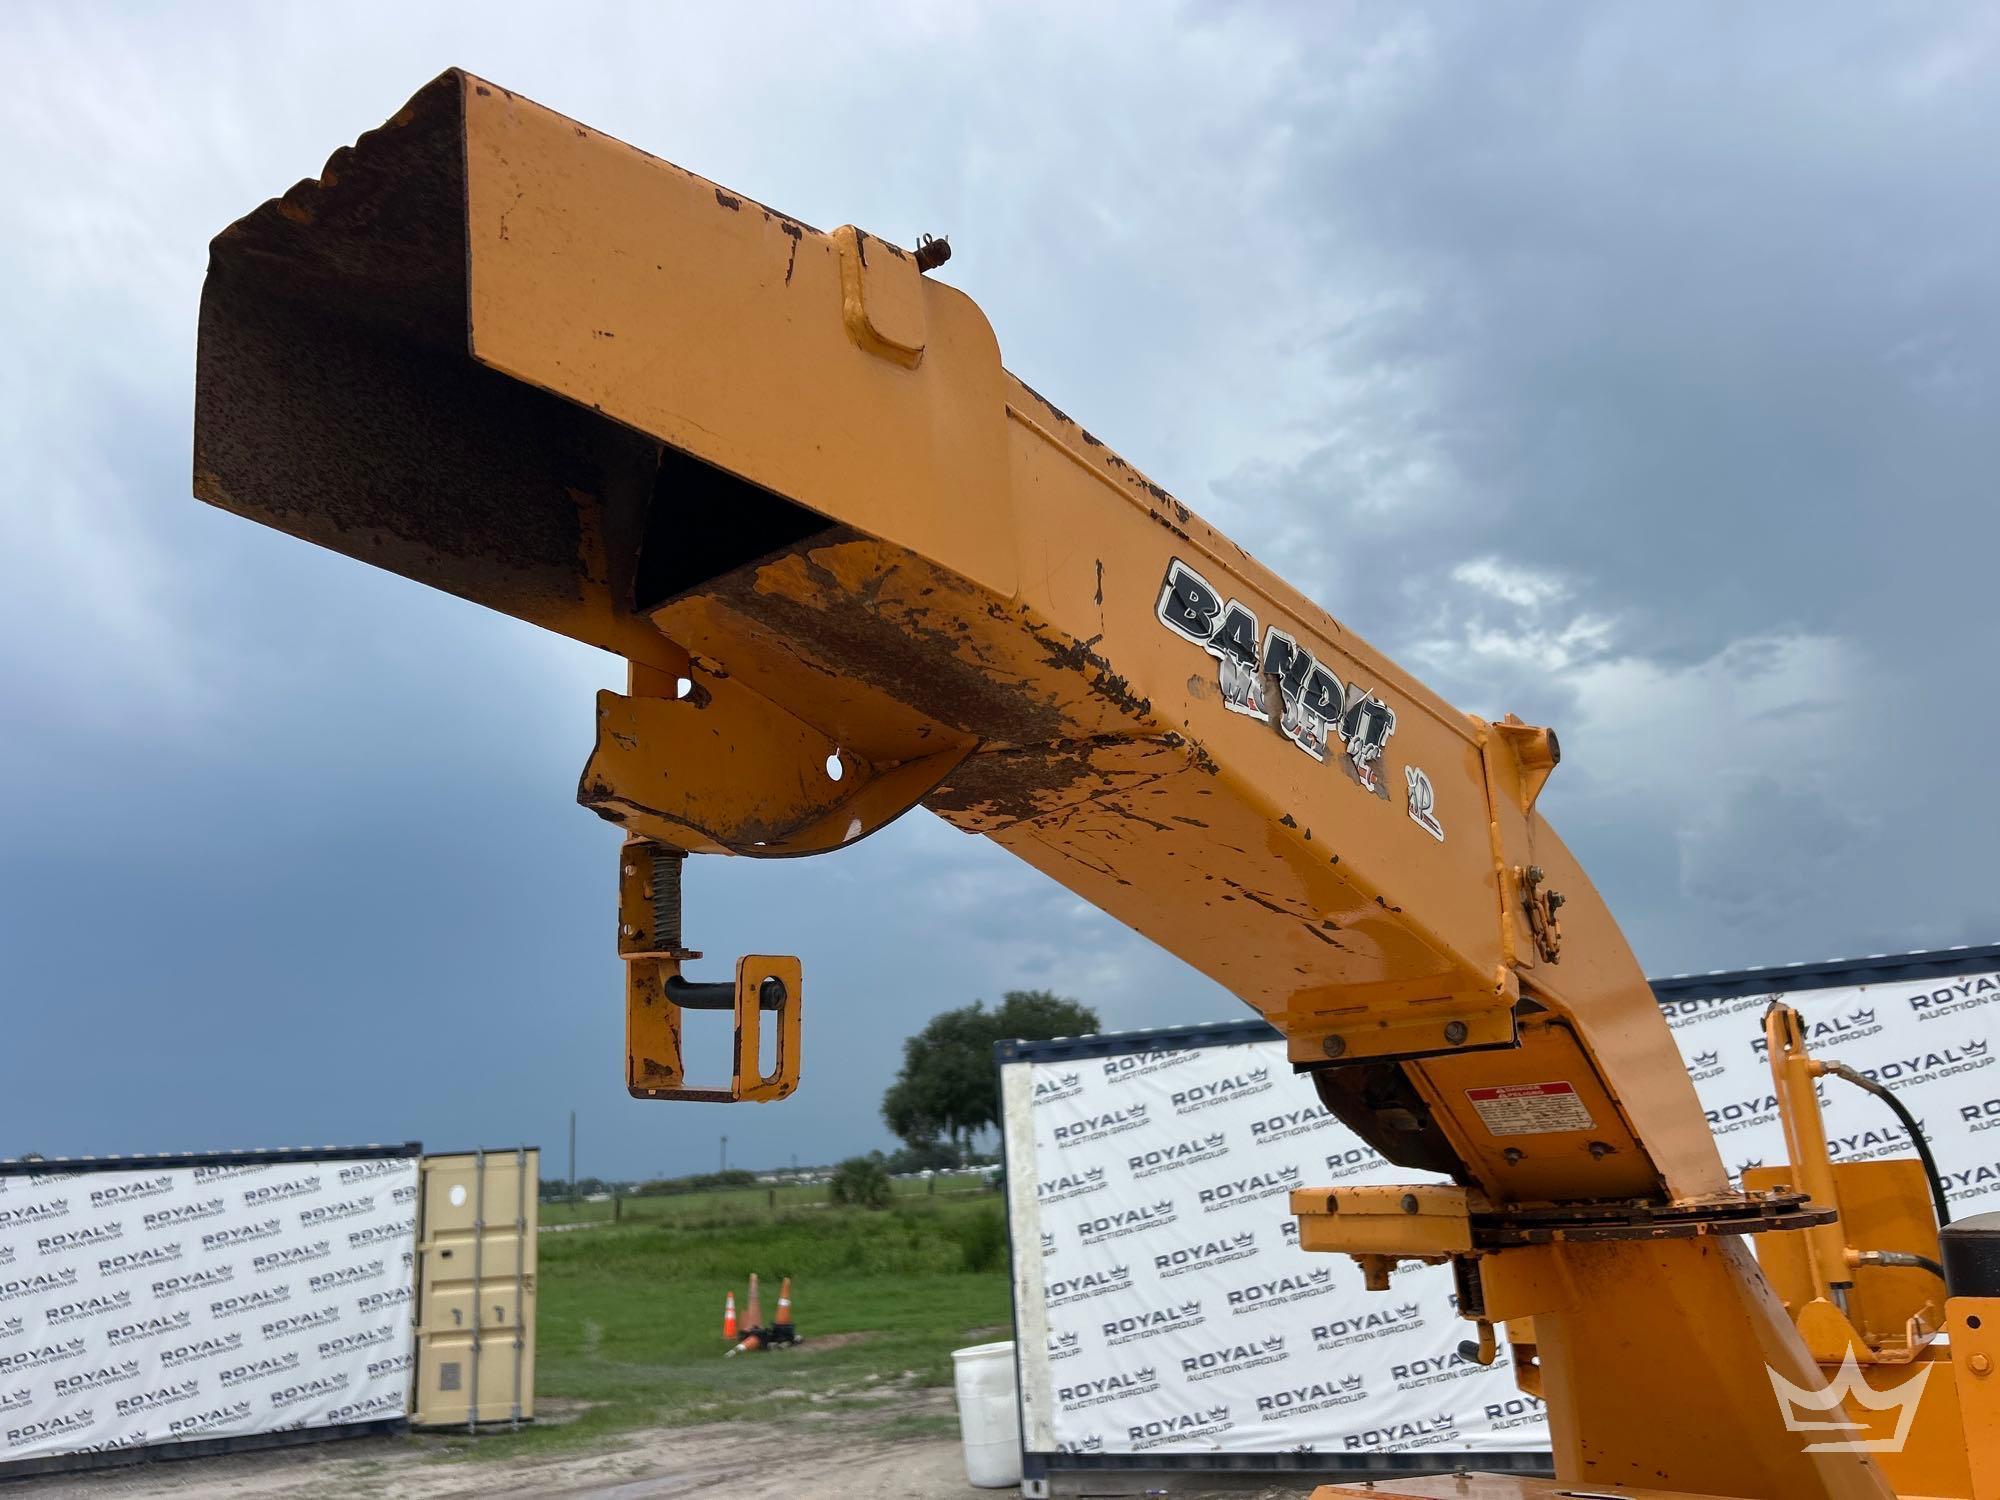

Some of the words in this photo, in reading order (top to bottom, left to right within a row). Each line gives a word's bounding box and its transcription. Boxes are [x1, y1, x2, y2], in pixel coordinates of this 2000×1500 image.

[1909, 975, 2000, 1010] ROYA
[1919, 997, 1989, 1021] AUCTION
[1828, 1025, 1882, 1046] GROUP
[1108, 1065, 1158, 1084] AUCTION
[1160, 1051, 1200, 1070] GROUP
[1884, 1072, 1937, 1092] CTION
[1939, 1056, 1996, 1077] GROUP
[1172, 1076, 1250, 1105] ROYAL
[1176, 1096, 1228, 1115] AUCTION
[1229, 1082, 1274, 1099] GROUP
[1705, 1095, 1778, 1123] ROYA
[1055, 1111, 1128, 1139] ROYAL
[1058, 1131, 1108, 1149] AUCTION
[1109, 1117, 1151, 1134] GROUP
[1256, 1127, 1310, 1145] AUCTION
[1312, 1117, 1340, 1130] GRO
[1828, 1128, 1900, 1155] OYAL
[1129, 1140, 1206, 1169] ROYAL
[1133, 1161, 1185, 1179] AUCTION
[1186, 1147, 1230, 1164] GROUP
[1326, 1146, 1377, 1169] ROY
[91, 1181, 155, 1201] ROYAL
[245, 1181, 304, 1200] ROYAL
[1065, 1182, 1108, 1198] GROUP
[1199, 1173, 1278, 1203] ROYAL
[0, 1204, 50, 1221] OYAL
[144, 1203, 207, 1224] ROYAL
[300, 1201, 359, 1221] ROYAL
[1204, 1194, 1258, 1213] AUCTION
[348, 1222, 406, 1242] ROYAL
[1078, 1207, 1154, 1235] ROYAL
[1082, 1228, 1134, 1245] AUCTION
[1135, 1214, 1178, 1231] GROUP
[38, 1227, 104, 1248] ROYAL
[202, 1224, 264, 1244] ROYAL
[99, 1248, 164, 1269] ROYAL
[254, 1245, 313, 1266] ROYAL
[1155, 1239, 1235, 1268] ROYAL
[1159, 1261, 1213, 1278] AUCTION
[1214, 1247, 1260, 1264] GROUP
[0, 1273, 59, 1294] OYAL
[152, 1270, 216, 1292] ROYAL
[310, 1265, 368, 1286] ROYAL
[1092, 1280, 1134, 1297] GROUP
[1228, 1275, 1310, 1304] ROYAL
[1232, 1297, 1288, 1315] AUCTION
[1289, 1284, 1336, 1301] GROUP
[46, 1296, 112, 1318] ROYAL
[211, 1290, 273, 1312] ROYAL
[107, 1316, 172, 1339] ROYAL
[262, 1311, 323, 1333] ROYAL
[1103, 1308, 1182, 1335] ROYAL
[1107, 1329, 1160, 1346] AUCTION
[1161, 1316, 1206, 1333] GROUP
[1312, 1310, 1398, 1340] ROYAL
[319, 1330, 377, 1353] ROYAL
[1317, 1333, 1375, 1350] AUCTION
[1376, 1319, 1426, 1337] GROUP
[0, 1344, 67, 1367] ROYAL
[161, 1338, 224, 1361] ROYAL
[1048, 1347, 1082, 1361] ROUP
[1182, 1343, 1264, 1371] ROYAL
[220, 1358, 282, 1380] ROYAL
[367, 1353, 413, 1373] ROYA
[1187, 1365, 1242, 1382] AUCTION
[1243, 1352, 1290, 1368] GROUP
[1390, 1353, 1464, 1380] ROYA
[55, 1366, 121, 1390] ROYAL
[271, 1378, 332, 1402] ROYAL
[1059, 1374, 1136, 1401] ROYAL
[1397, 1369, 1458, 1391] AUCTION
[116, 1386, 181, 1410] ROYAL
[1063, 1395, 1115, 1411] AUCTION
[1116, 1383, 1160, 1399] GROUP
[1257, 1382, 1342, 1410] ROYAL
[1262, 1404, 1319, 1421] AUCTION
[1320, 1391, 1369, 1408] GROUP
[169, 1407, 233, 1432] ROYAL
[328, 1397, 386, 1420] ROYAL
[1484, 1397, 1541, 1420] ROY
[7, 1415, 75, 1439] ROYAL
[1128, 1412, 1210, 1441] ROYAL
[1187, 1422, 1234, 1438] GROUP
[1491, 1413, 1547, 1432] AUCTIO
[1343, 1420, 1432, 1450] ROYAL
[1411, 1431, 1459, 1449] GROUP
